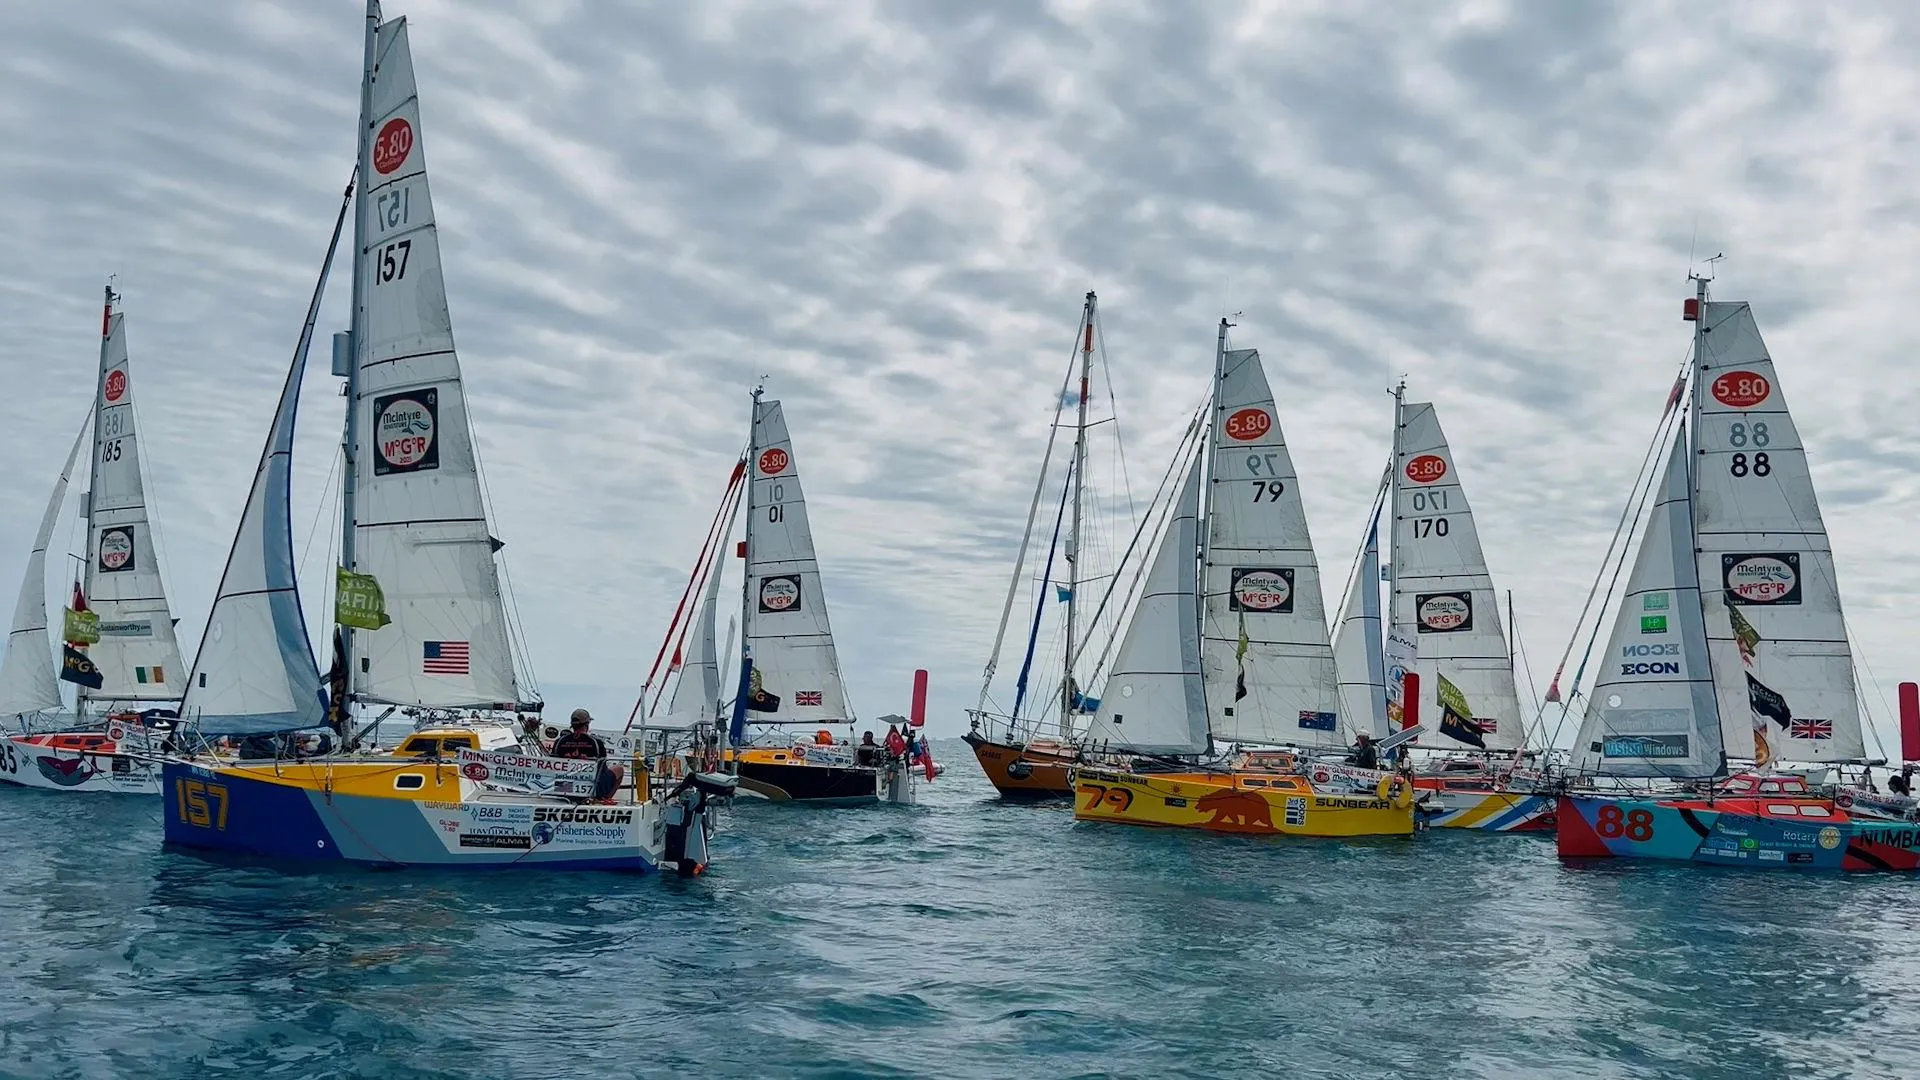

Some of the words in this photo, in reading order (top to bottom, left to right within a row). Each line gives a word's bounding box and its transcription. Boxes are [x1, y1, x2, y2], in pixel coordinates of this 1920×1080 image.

[376, 126, 410, 162] 5.80
[376, 240, 412, 286] 157
[106, 375, 124, 394] 5.80
[1717, 379, 1766, 396] 5.80
[384, 411, 421, 426] McIntyre
[1229, 414, 1268, 432] 5.80
[102, 440, 122, 464] 185
[760, 453, 787, 468] 5.80
[1408, 460, 1444, 475] 5.80
[1730, 452, 1771, 478] 88
[1252, 480, 1284, 503] 79
[768, 505, 784, 523] 01
[1414, 518, 1449, 539] 170
[1736, 564, 1782, 574] McIntyre
[1621, 662, 1680, 676] ECON
[1644, 743, 1684, 756] Windows
[464, 766, 487, 777] 5.80
[495, 766, 541, 780] McIntyre
[574, 784, 593, 794] 157
[176, 776, 229, 831] 157
[1077, 783, 1134, 814] 79
[1315, 798, 1390, 810] SUNBEAR
[479, 807, 504, 818] B&B
[533, 808, 632, 824] SKOOKUM
[1298, 798, 1306, 826] DOORS
[1595, 805, 1654, 842] 88
[556, 824, 594, 838] Fisheries
[596, 826, 626, 840] Supply
[1783, 831, 1817, 843] Rotary
